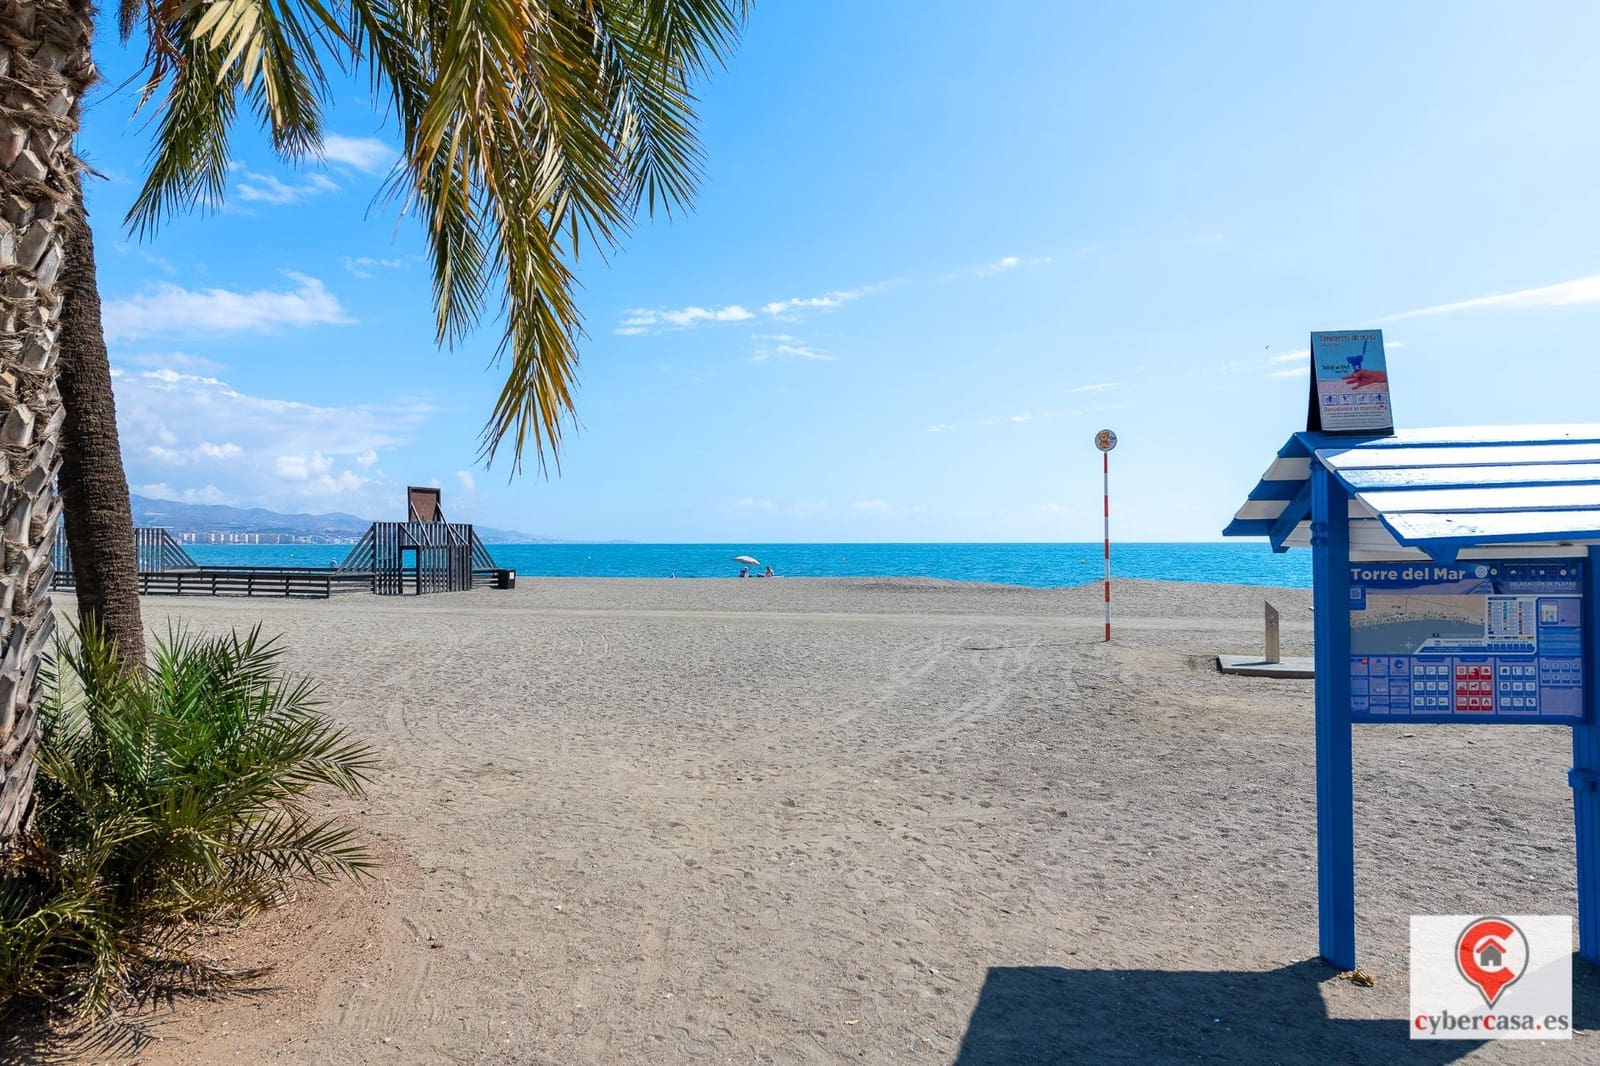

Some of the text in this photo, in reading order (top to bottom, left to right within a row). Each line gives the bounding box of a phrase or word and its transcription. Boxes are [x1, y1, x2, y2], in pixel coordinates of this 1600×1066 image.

[1350, 567, 1466, 581] Torre del Mar
